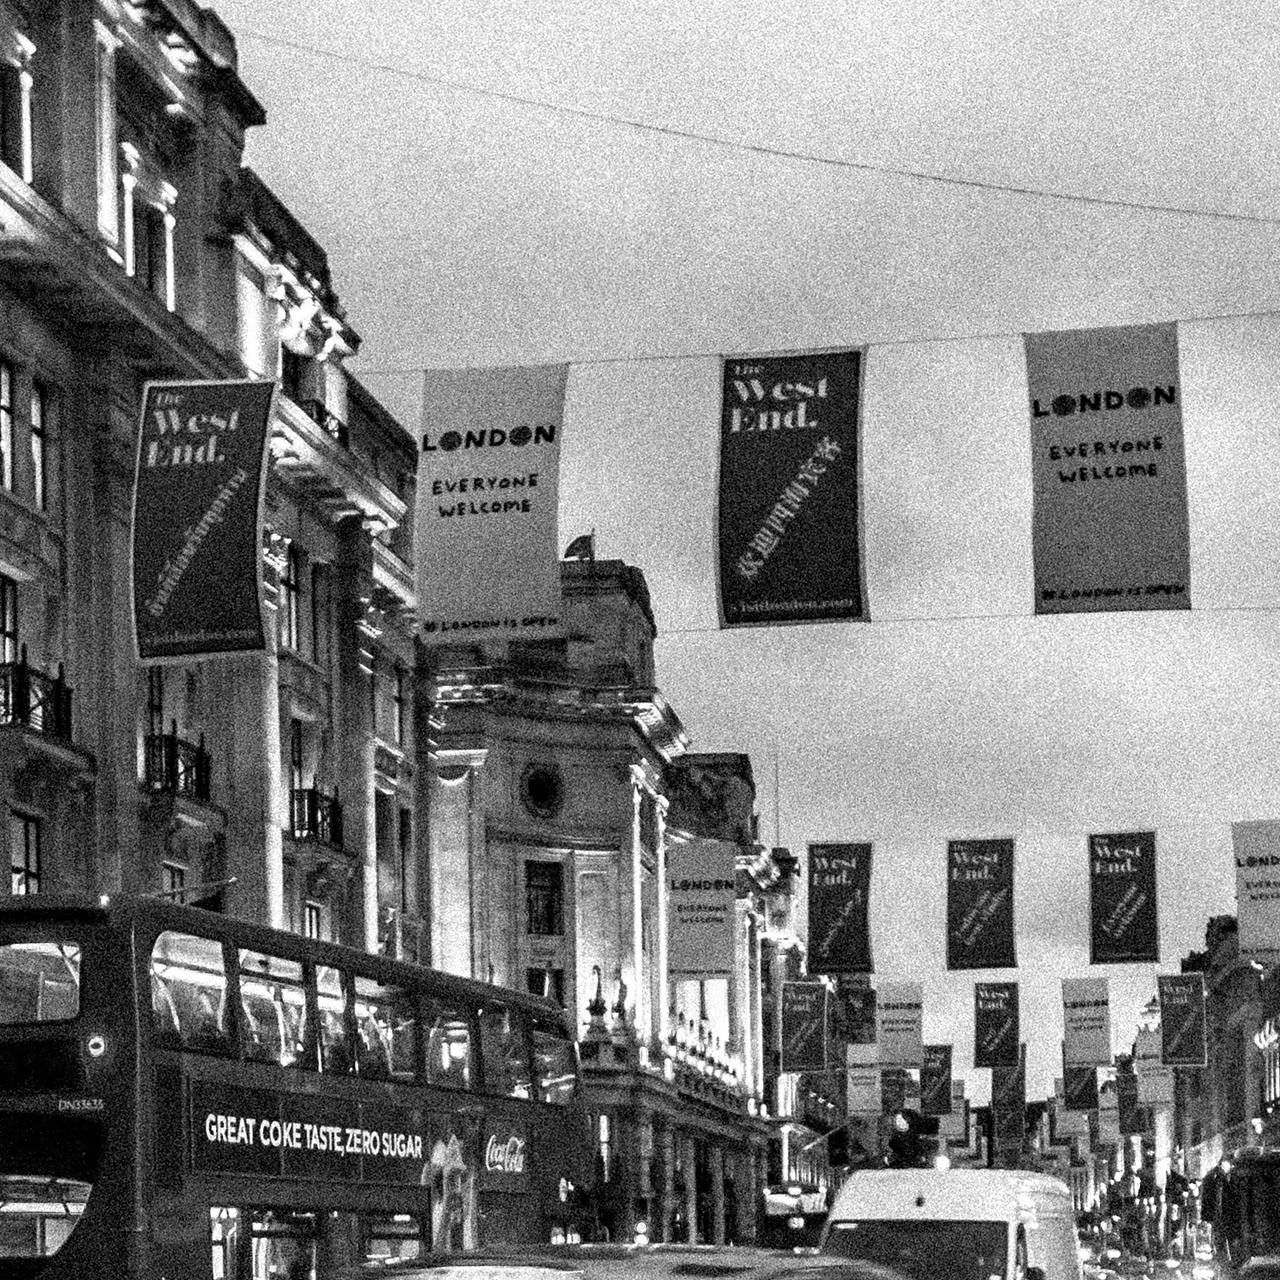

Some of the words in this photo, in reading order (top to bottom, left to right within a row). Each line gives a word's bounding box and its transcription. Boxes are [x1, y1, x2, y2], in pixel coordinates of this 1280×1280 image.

[733, 377, 827, 402] West
[1032, 385, 1176, 418] LONDON
[153, 409, 240, 435] West
[730, 402, 818, 433] End.
[422, 425, 556, 452] LONDON
[1049, 436, 1163, 460] EVERYONE
[147, 435, 225, 467] End.
[432, 473, 539, 495] EVERYONE
[1058, 463, 1158, 483] WELCOME
[438, 499, 531, 518] WELCOME
[953, 852, 999, 864] West
[1094, 846, 1141, 858] West
[671, 880, 734, 891] LONDON
[205, 1113, 256, 1145] GREAT
[259, 1119, 302, 1149] COKE
[304, 1123, 345, 1157] TASTE,
[346, 1127, 381, 1155] ZERO
[382, 1132, 423, 1159] SUGAR
